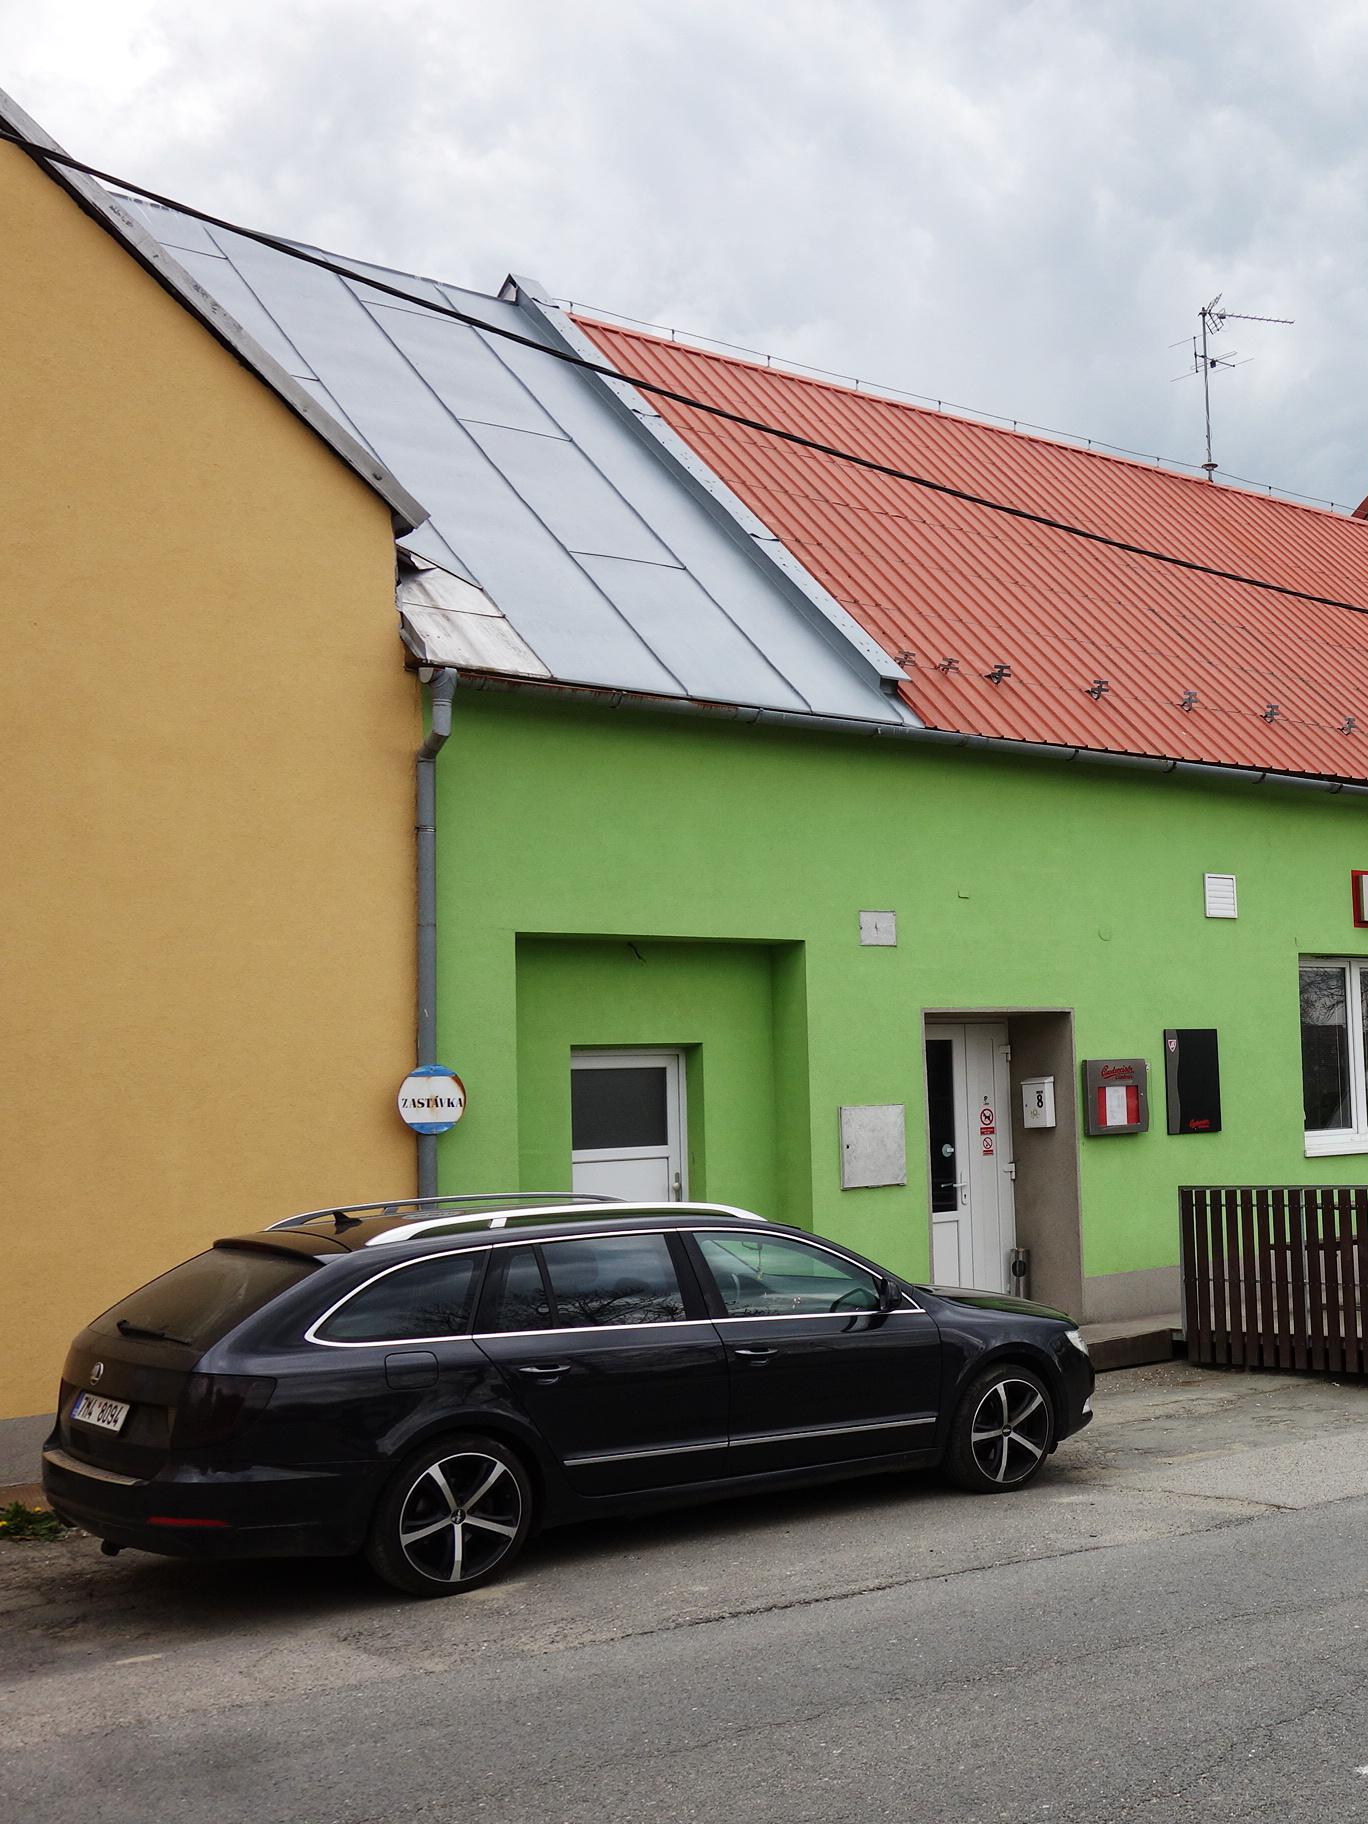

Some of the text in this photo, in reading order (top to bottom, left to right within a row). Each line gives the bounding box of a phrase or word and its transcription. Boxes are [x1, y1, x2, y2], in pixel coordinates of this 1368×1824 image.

[401, 1095, 463, 1109] ZASTÁVKA
[1036, 1094, 1044, 1108] 8
[97, 1402, 125, 1427] 8094
